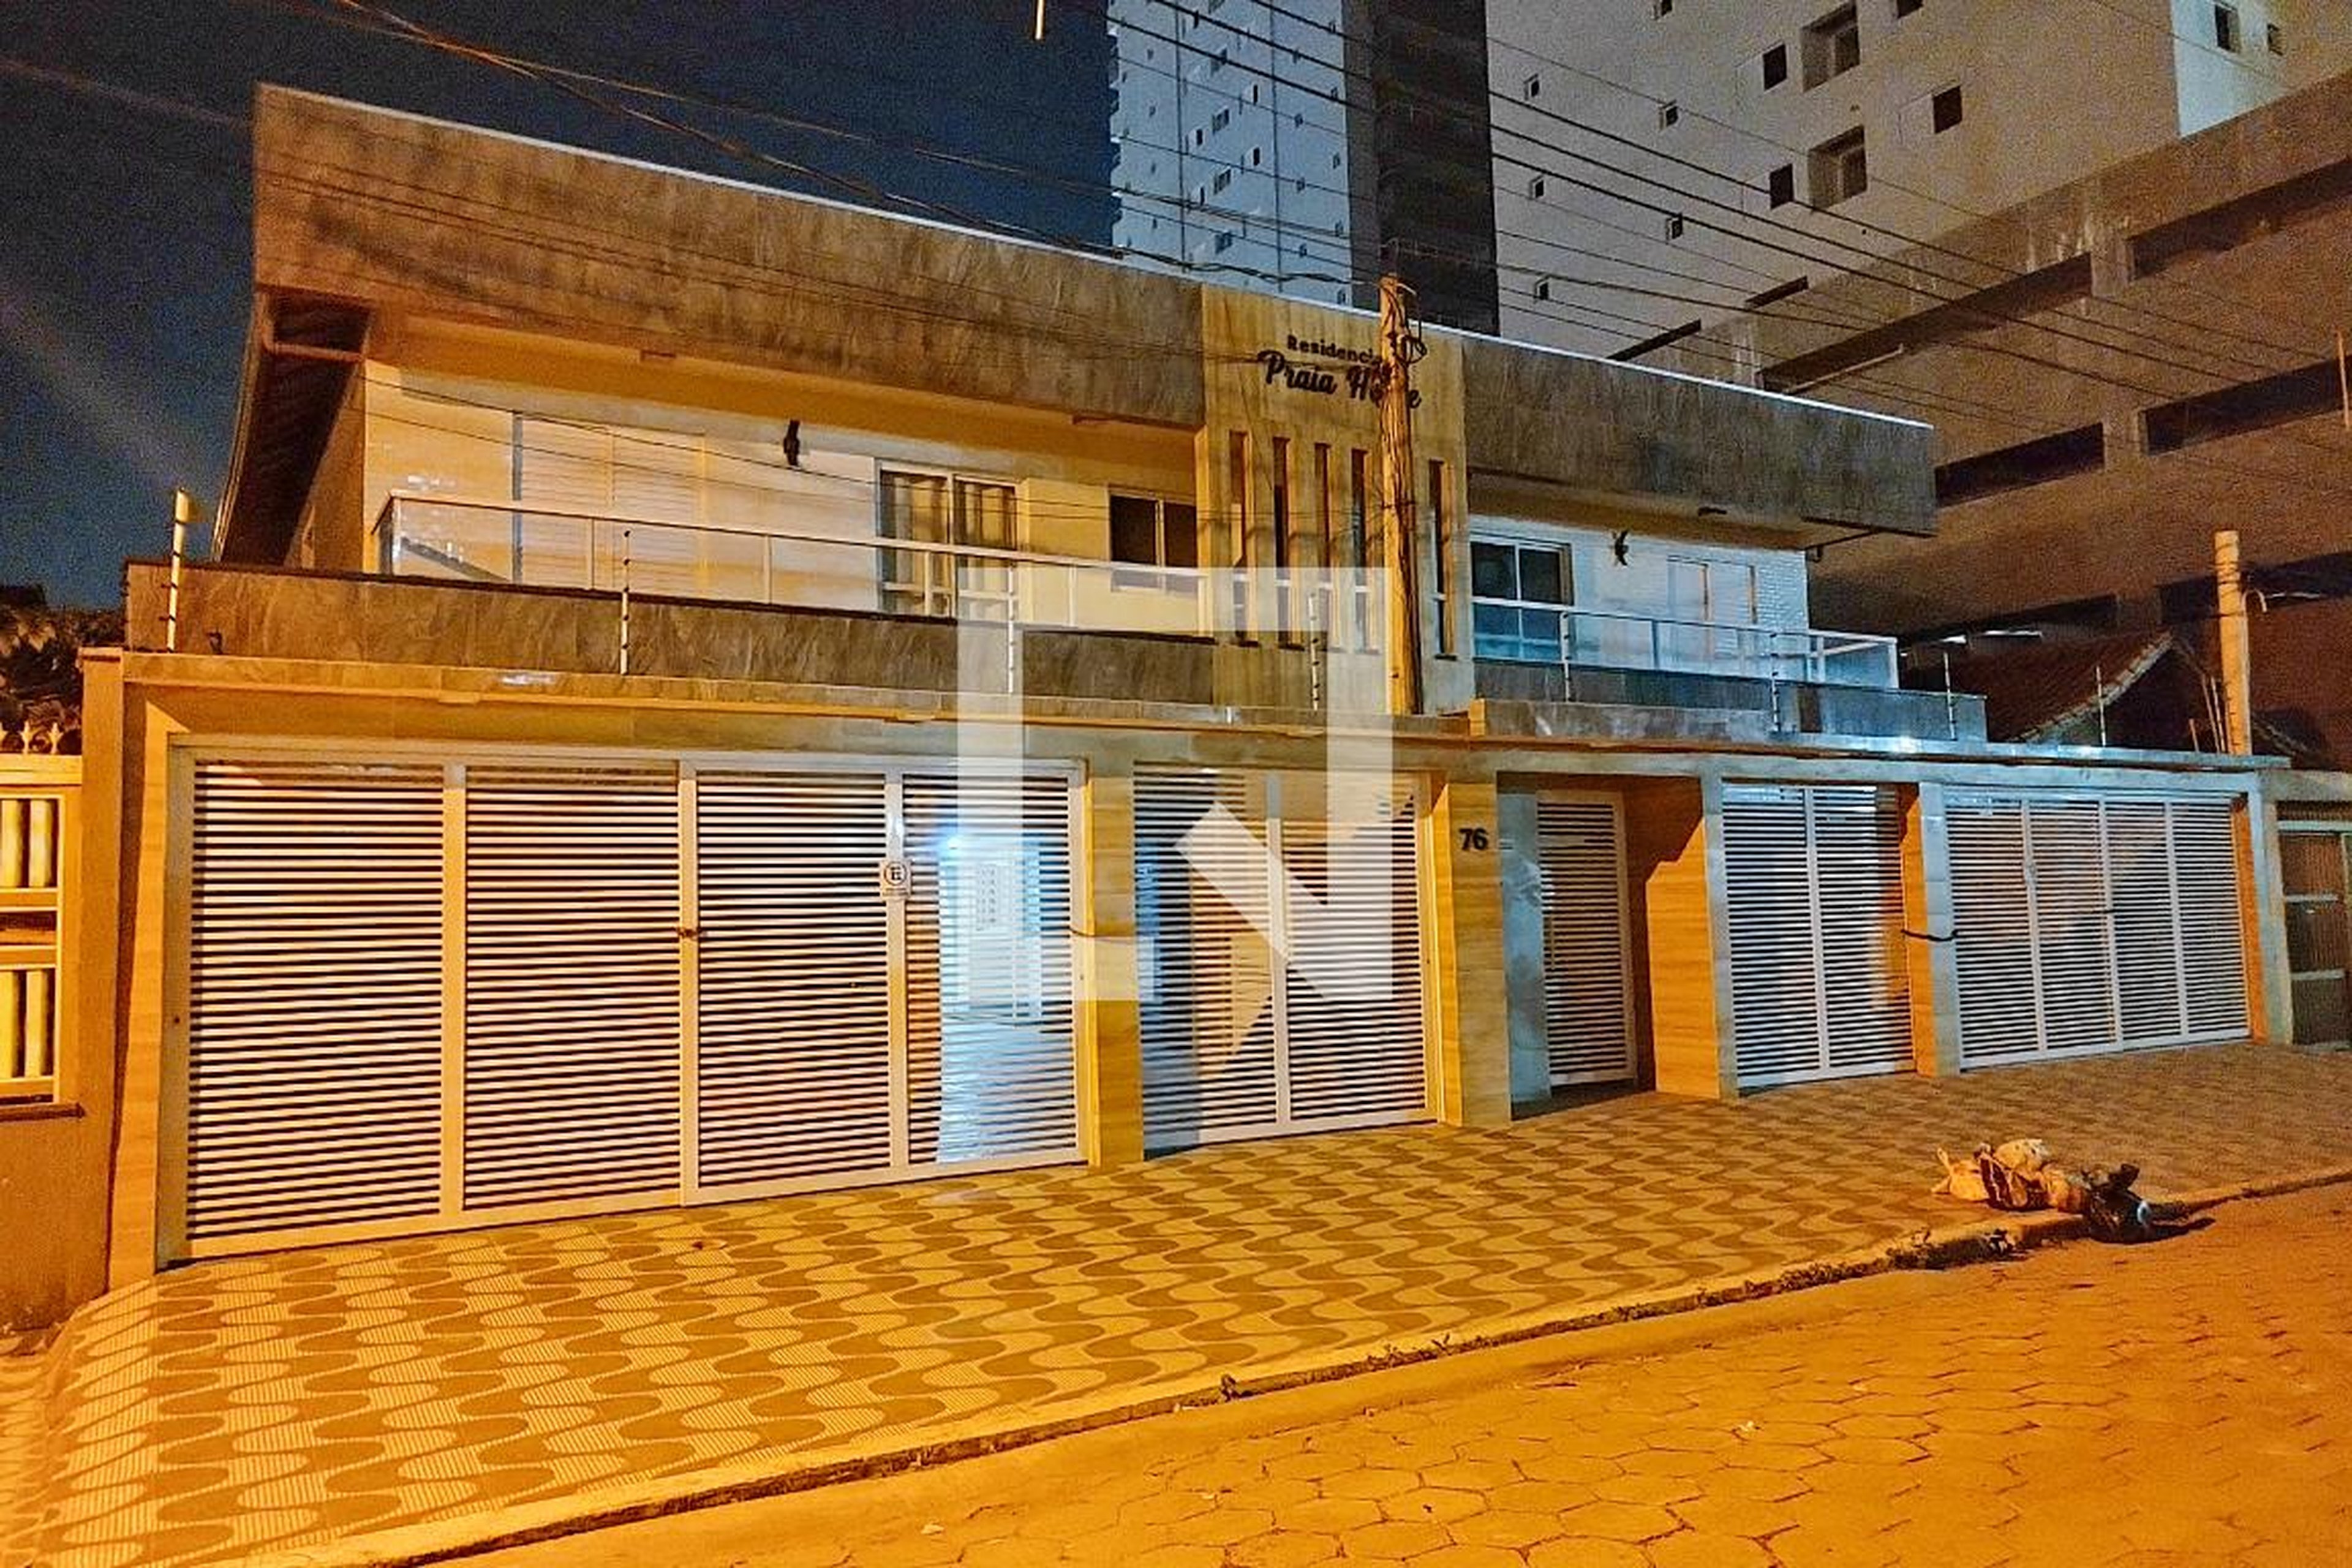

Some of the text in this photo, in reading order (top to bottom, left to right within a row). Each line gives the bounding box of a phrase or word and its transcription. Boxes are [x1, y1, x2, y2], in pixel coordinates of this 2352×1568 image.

[1287, 334, 1385, 366] Residencia
[1256, 350, 1422, 409] Praia Hoe
[1459, 827, 1488, 851] 76
